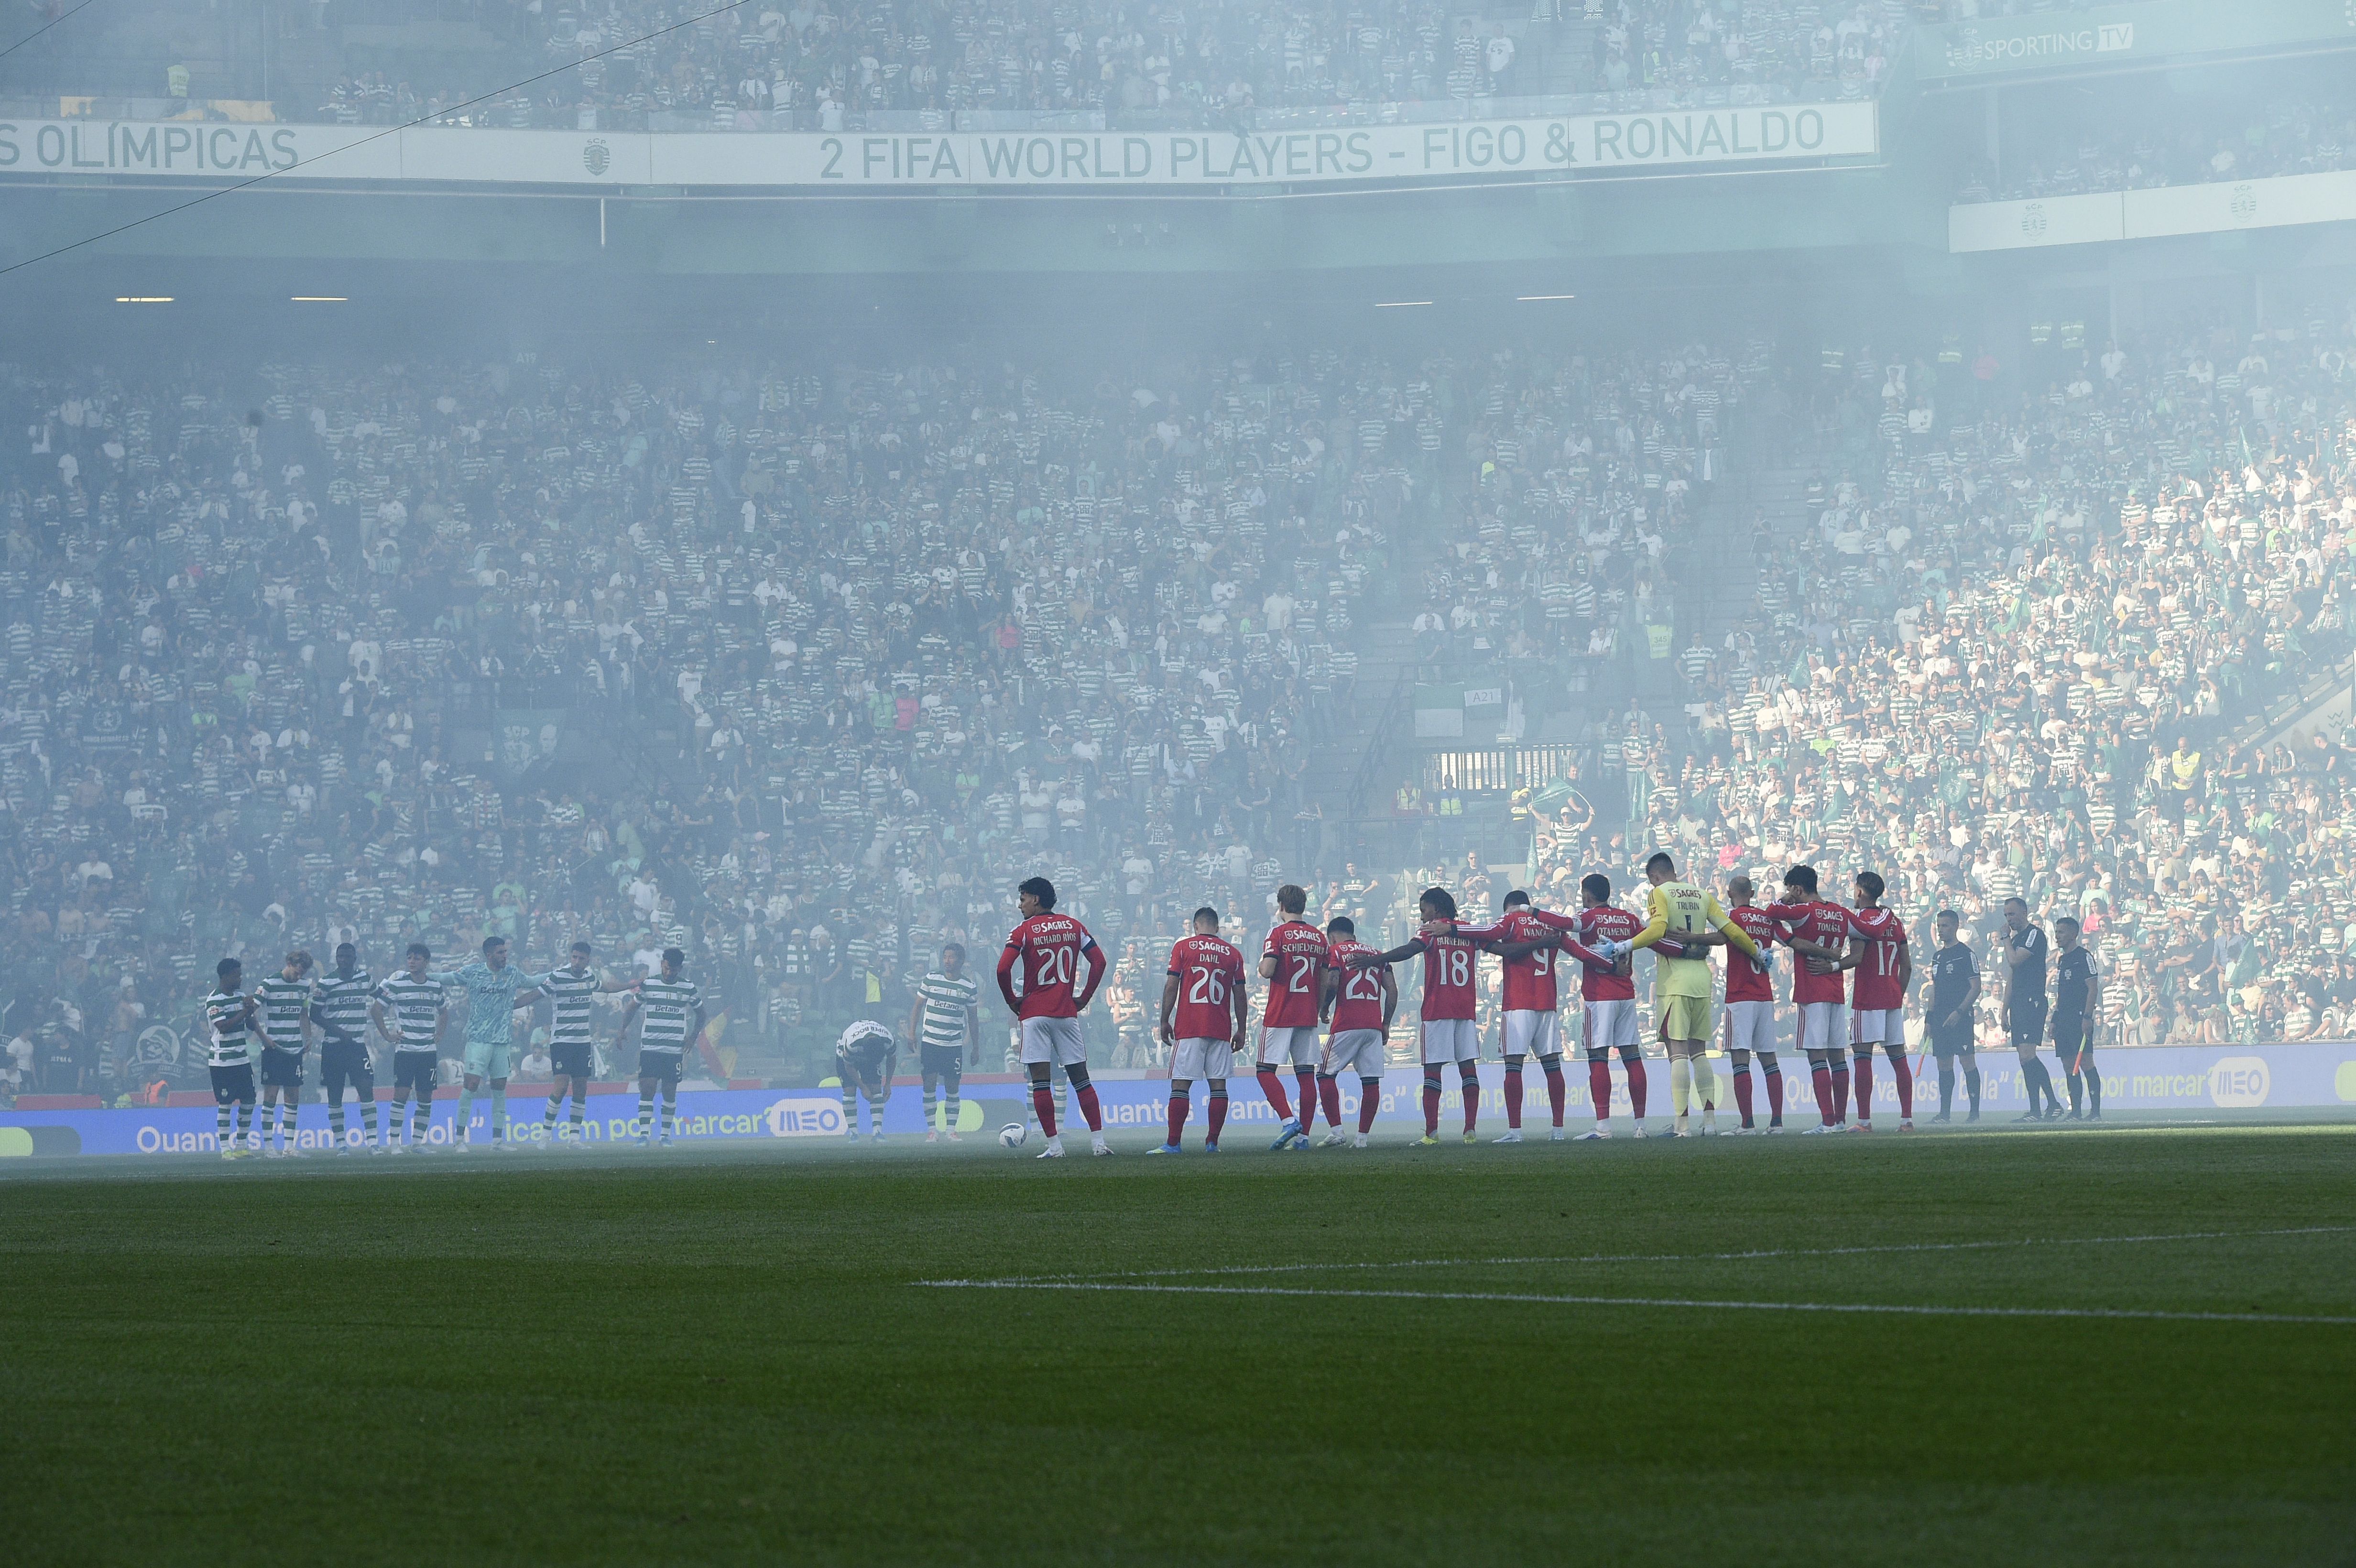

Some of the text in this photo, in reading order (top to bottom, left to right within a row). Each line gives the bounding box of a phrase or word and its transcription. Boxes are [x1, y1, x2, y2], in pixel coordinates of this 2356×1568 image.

[1984, 27, 2131, 60] SPORTING TV
[36, 121, 299, 172] OLÍMPICAS
[820, 138, 844, 179] 2
[863, 137, 962, 179] FIFA
[980, 136, 1152, 178] WORLD
[1171, 132, 1373, 177] PLAYERS
[1423, 124, 1527, 169] FIGO
[1543, 122, 1575, 163] &
[1594, 109, 1825, 161] RONALDO
[1473, 692, 1494, 703] A21
[1676, 889, 1702, 899] SAGRES
[1676, 902, 1700, 910] TRUBIN
[1041, 920, 1073, 933] SAGRES
[1597, 927, 1631, 936] OTAMENDI
[1033, 931, 1077, 946] RICHARD RÍOS
[1294, 930, 1321, 943] SAGRES
[1437, 936, 1470, 947] BARREIRO
[1199, 940, 1231, 956] SAGRES
[1349, 944, 1378, 955] SAGRES
[1037, 946, 1074, 985] 20
[1200, 953, 1220, 964] DAHL
[1532, 947, 1549, 976] 9
[1876, 940, 1898, 976] 17
[1439, 948, 1469, 987] 18
[1189, 966, 1226, 1005] 26
[1346, 965, 1379, 1001] 25
[655, 1005, 679, 1013] Betano
[934, 1000, 959, 1011] Betano
[851, 1026, 869, 1038] BOCK
[871, 1025, 888, 1035] SUPER
[954, 1057, 960, 1069] 5
[1958, 1070, 2009, 1101] bla”
[2217, 1069, 2263, 1096] MEO
[1611, 1081, 1630, 1105] EO
[779, 1109, 840, 1132] MEO
[137, 1126, 262, 1153] Quans
[505, 1115, 600, 1142] icaram
